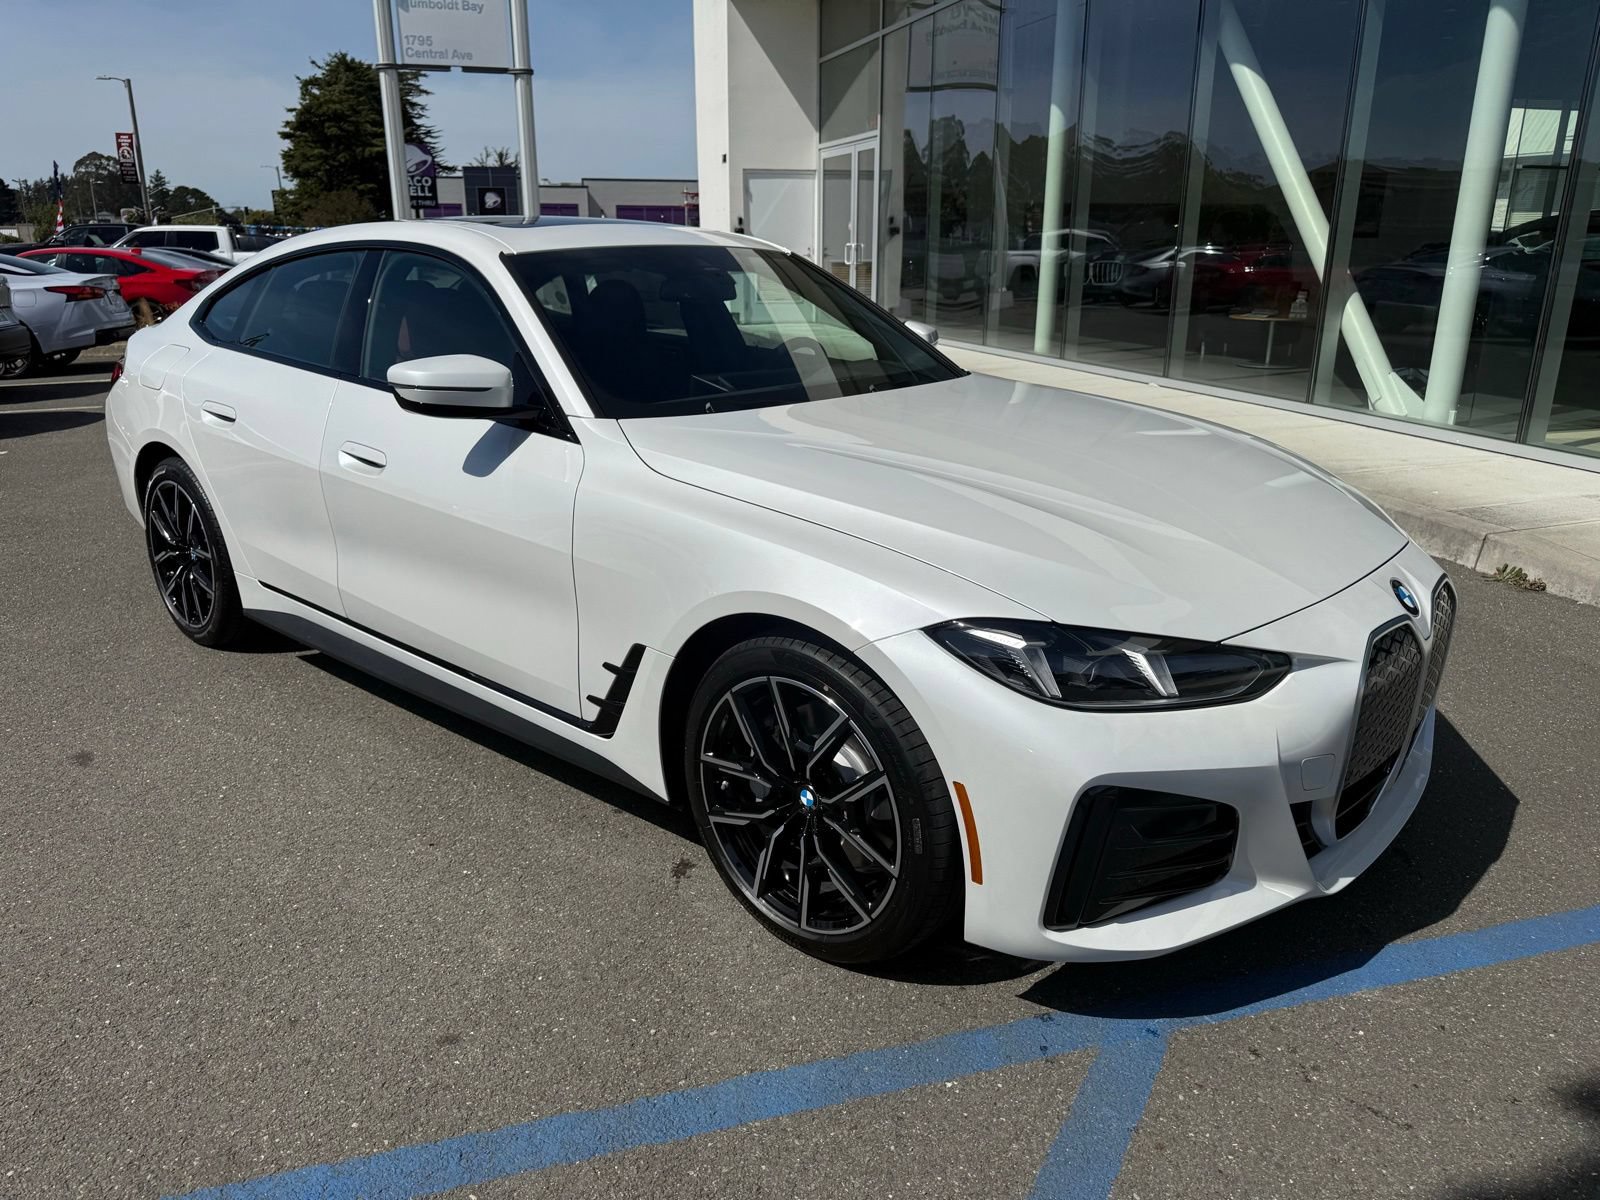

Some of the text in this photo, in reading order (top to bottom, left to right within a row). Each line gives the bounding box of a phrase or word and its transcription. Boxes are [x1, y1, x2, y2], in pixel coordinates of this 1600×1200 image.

[409, 0, 484, 14] umboldt Bay
[404, 35, 433, 46] 1795
[405, 47, 473, 61] Central Ave
[408, 176, 432, 186] ACO
[409, 186, 432, 196] ELL
